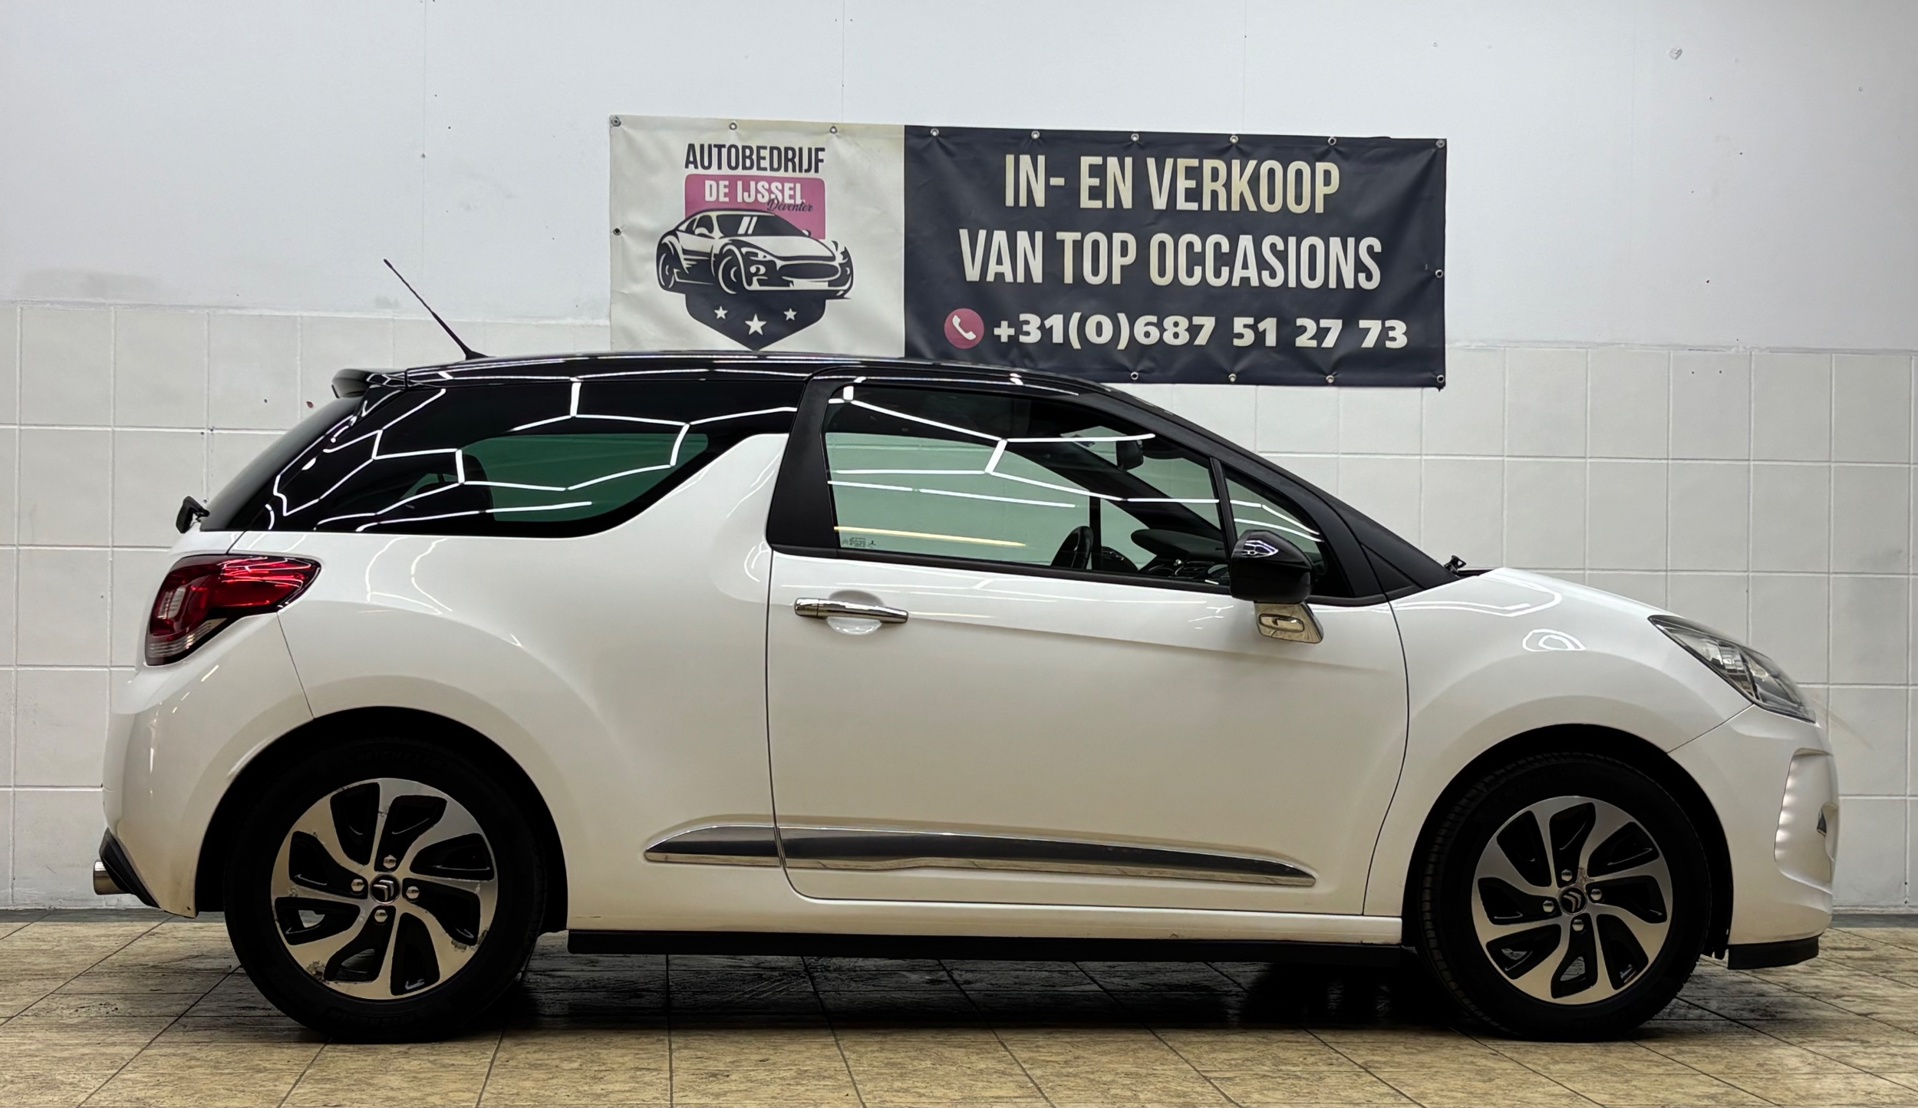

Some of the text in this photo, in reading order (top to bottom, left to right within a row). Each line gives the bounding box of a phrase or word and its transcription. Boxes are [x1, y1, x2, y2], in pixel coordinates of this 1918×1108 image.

[684, 143, 826, 174] AUTOBEDRIJF
[704, 179, 805, 205] DE IJSSEL
[1005, 153, 1340, 214] IN- EN VERKOOP
[767, 197, 814, 213] Deventer
[958, 228, 1382, 290] VAN TOP OCCASIONS
[993, 311, 1408, 350] +31(0)687 51 27 73
